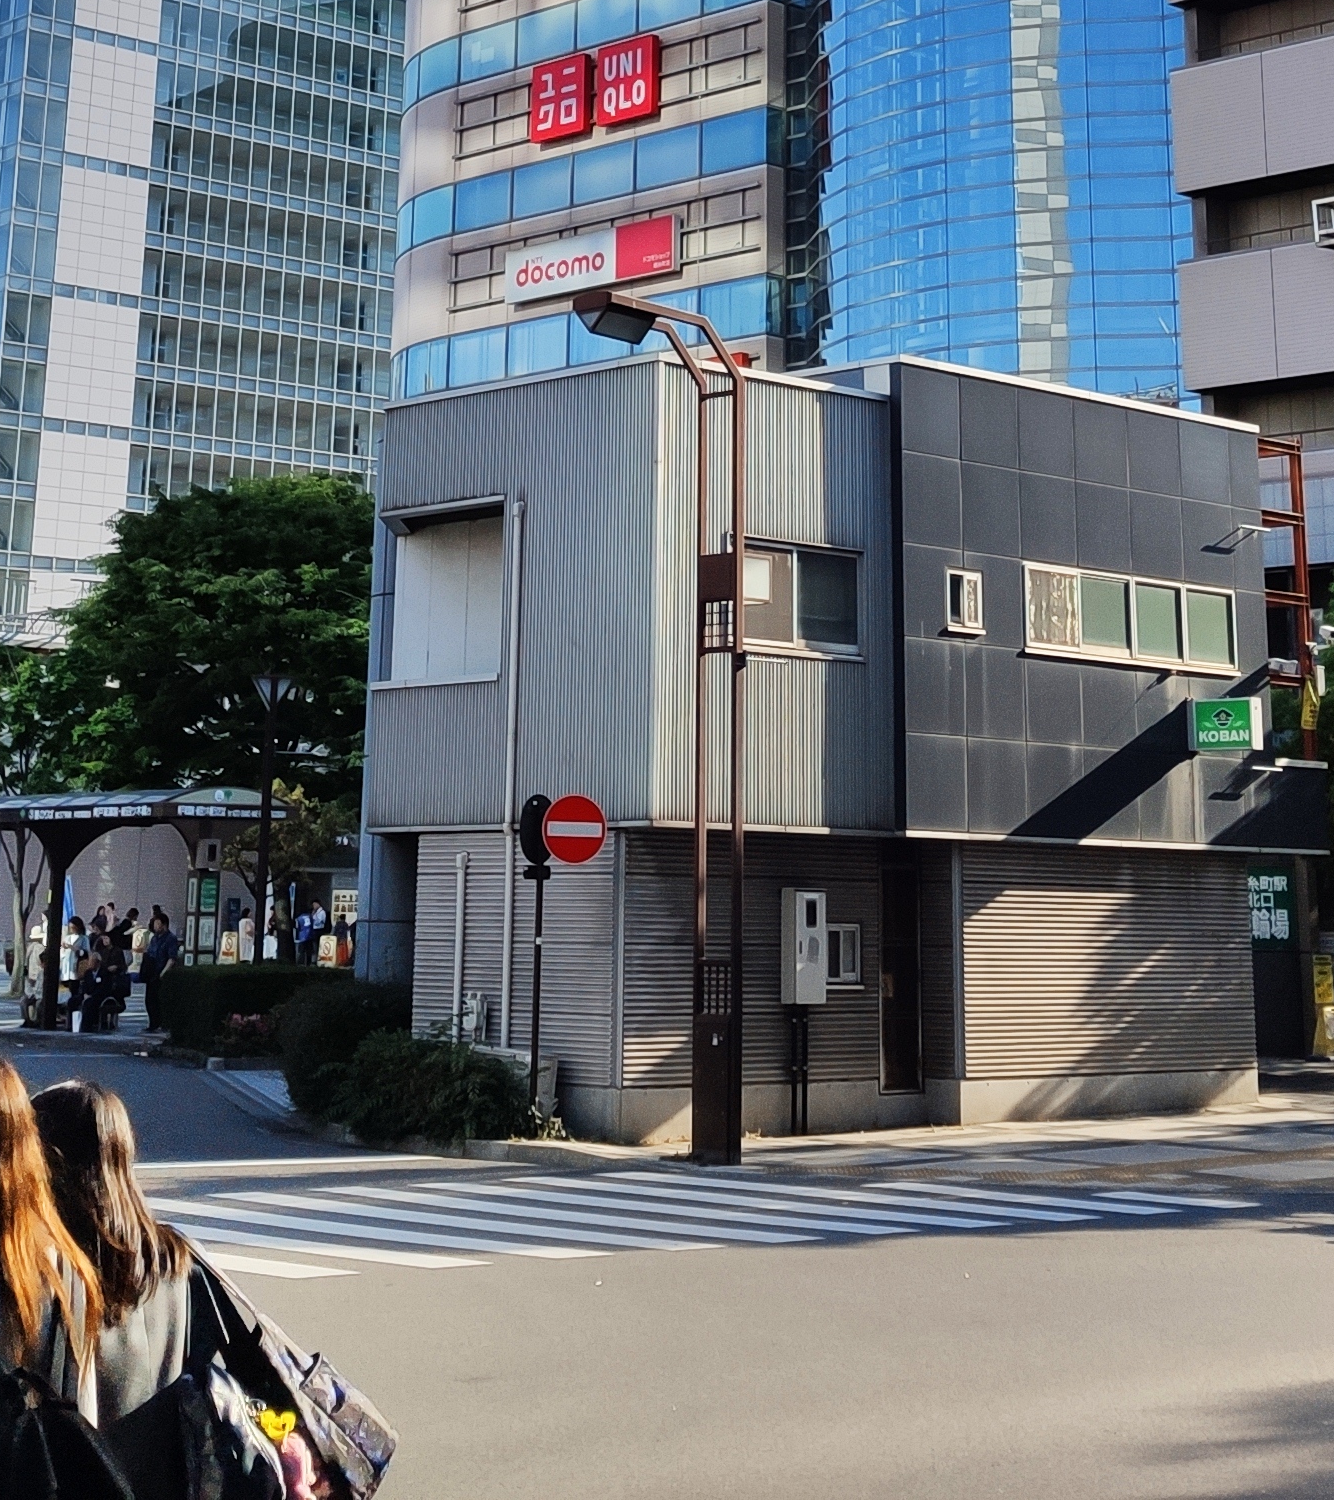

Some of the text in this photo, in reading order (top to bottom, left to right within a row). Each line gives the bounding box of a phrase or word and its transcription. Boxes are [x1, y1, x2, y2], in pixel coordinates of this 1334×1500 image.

[516, 252, 605, 287] docomo
[1199, 729, 1249, 743] KOBAN
[1248, 892, 1274, 908] 北口
[1250, 908, 1290, 939] 輪場
